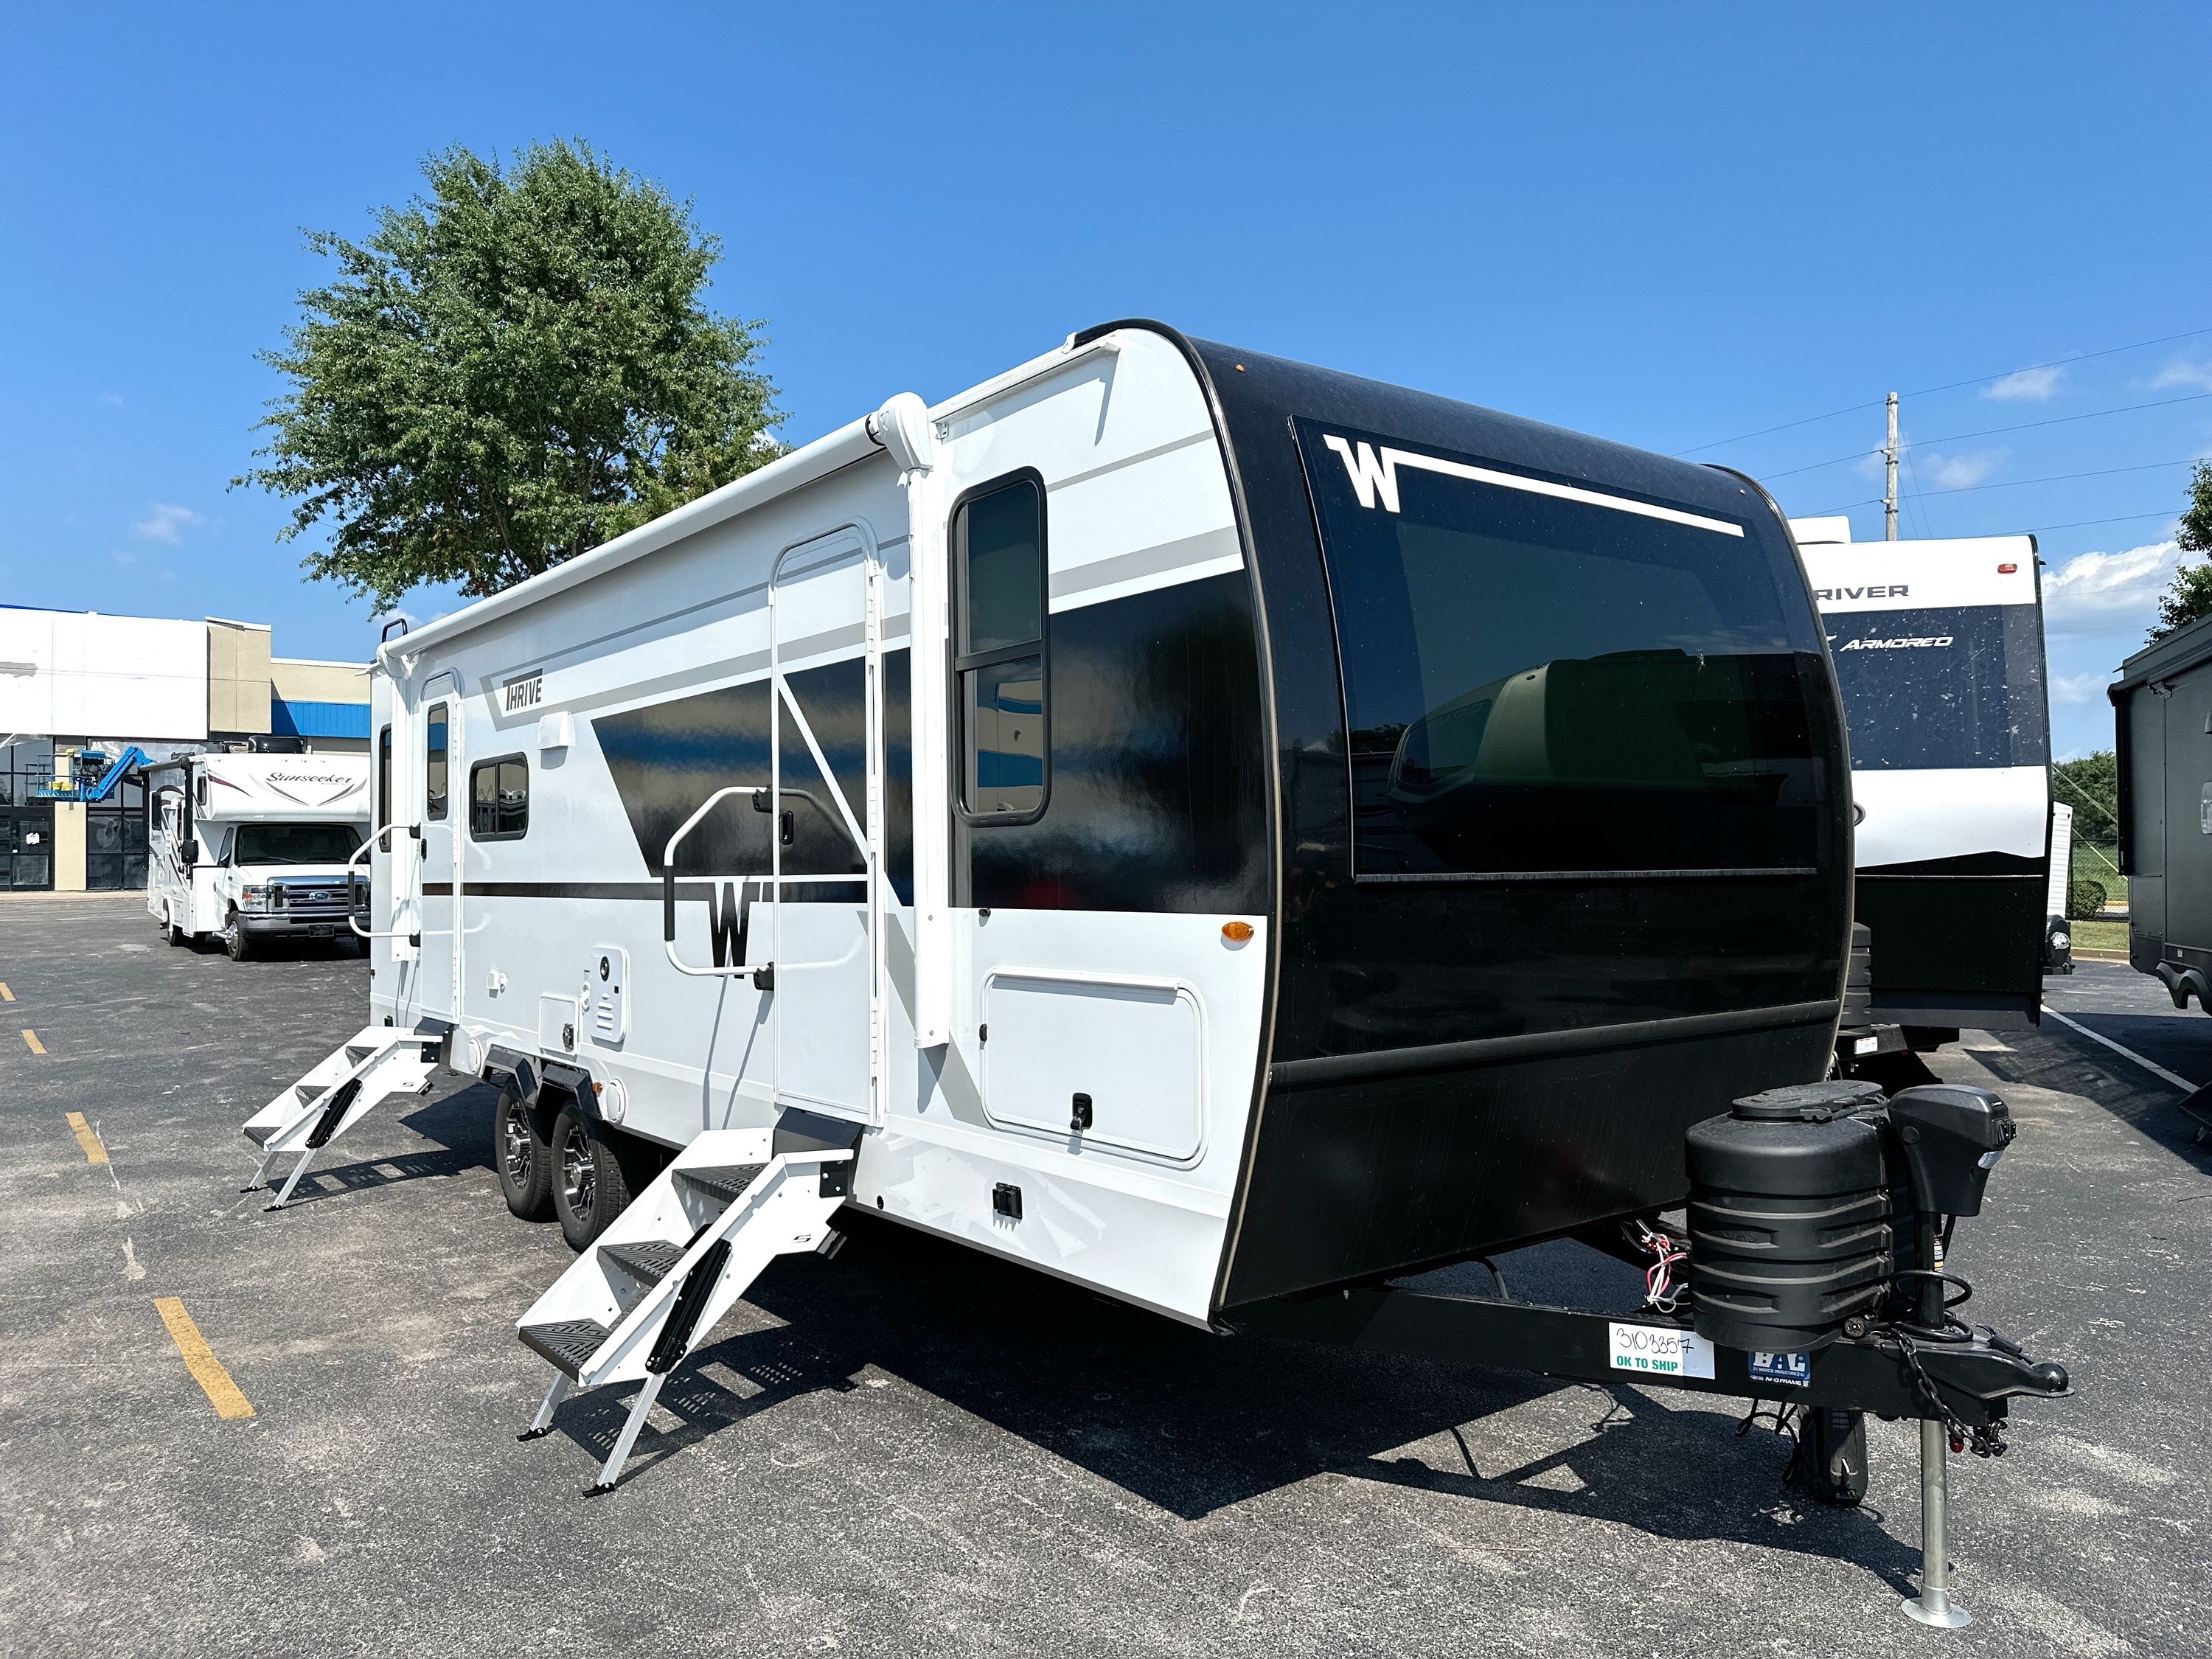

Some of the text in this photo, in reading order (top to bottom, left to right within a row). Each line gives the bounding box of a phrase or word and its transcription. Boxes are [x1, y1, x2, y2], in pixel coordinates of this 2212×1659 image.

[1323, 434, 1400, 513] W
[1812, 585, 1910, 601] RIVER
[1839, 636, 1954, 652] ARMORED
[503, 667, 543, 712] THRIVE
[265, 771, 353, 783] Sunseeker
[708, 881, 761, 980] W
[1722, 1229, 1757, 1243] GAS
[1616, 1355, 1678, 1371] OK TO SHIP
